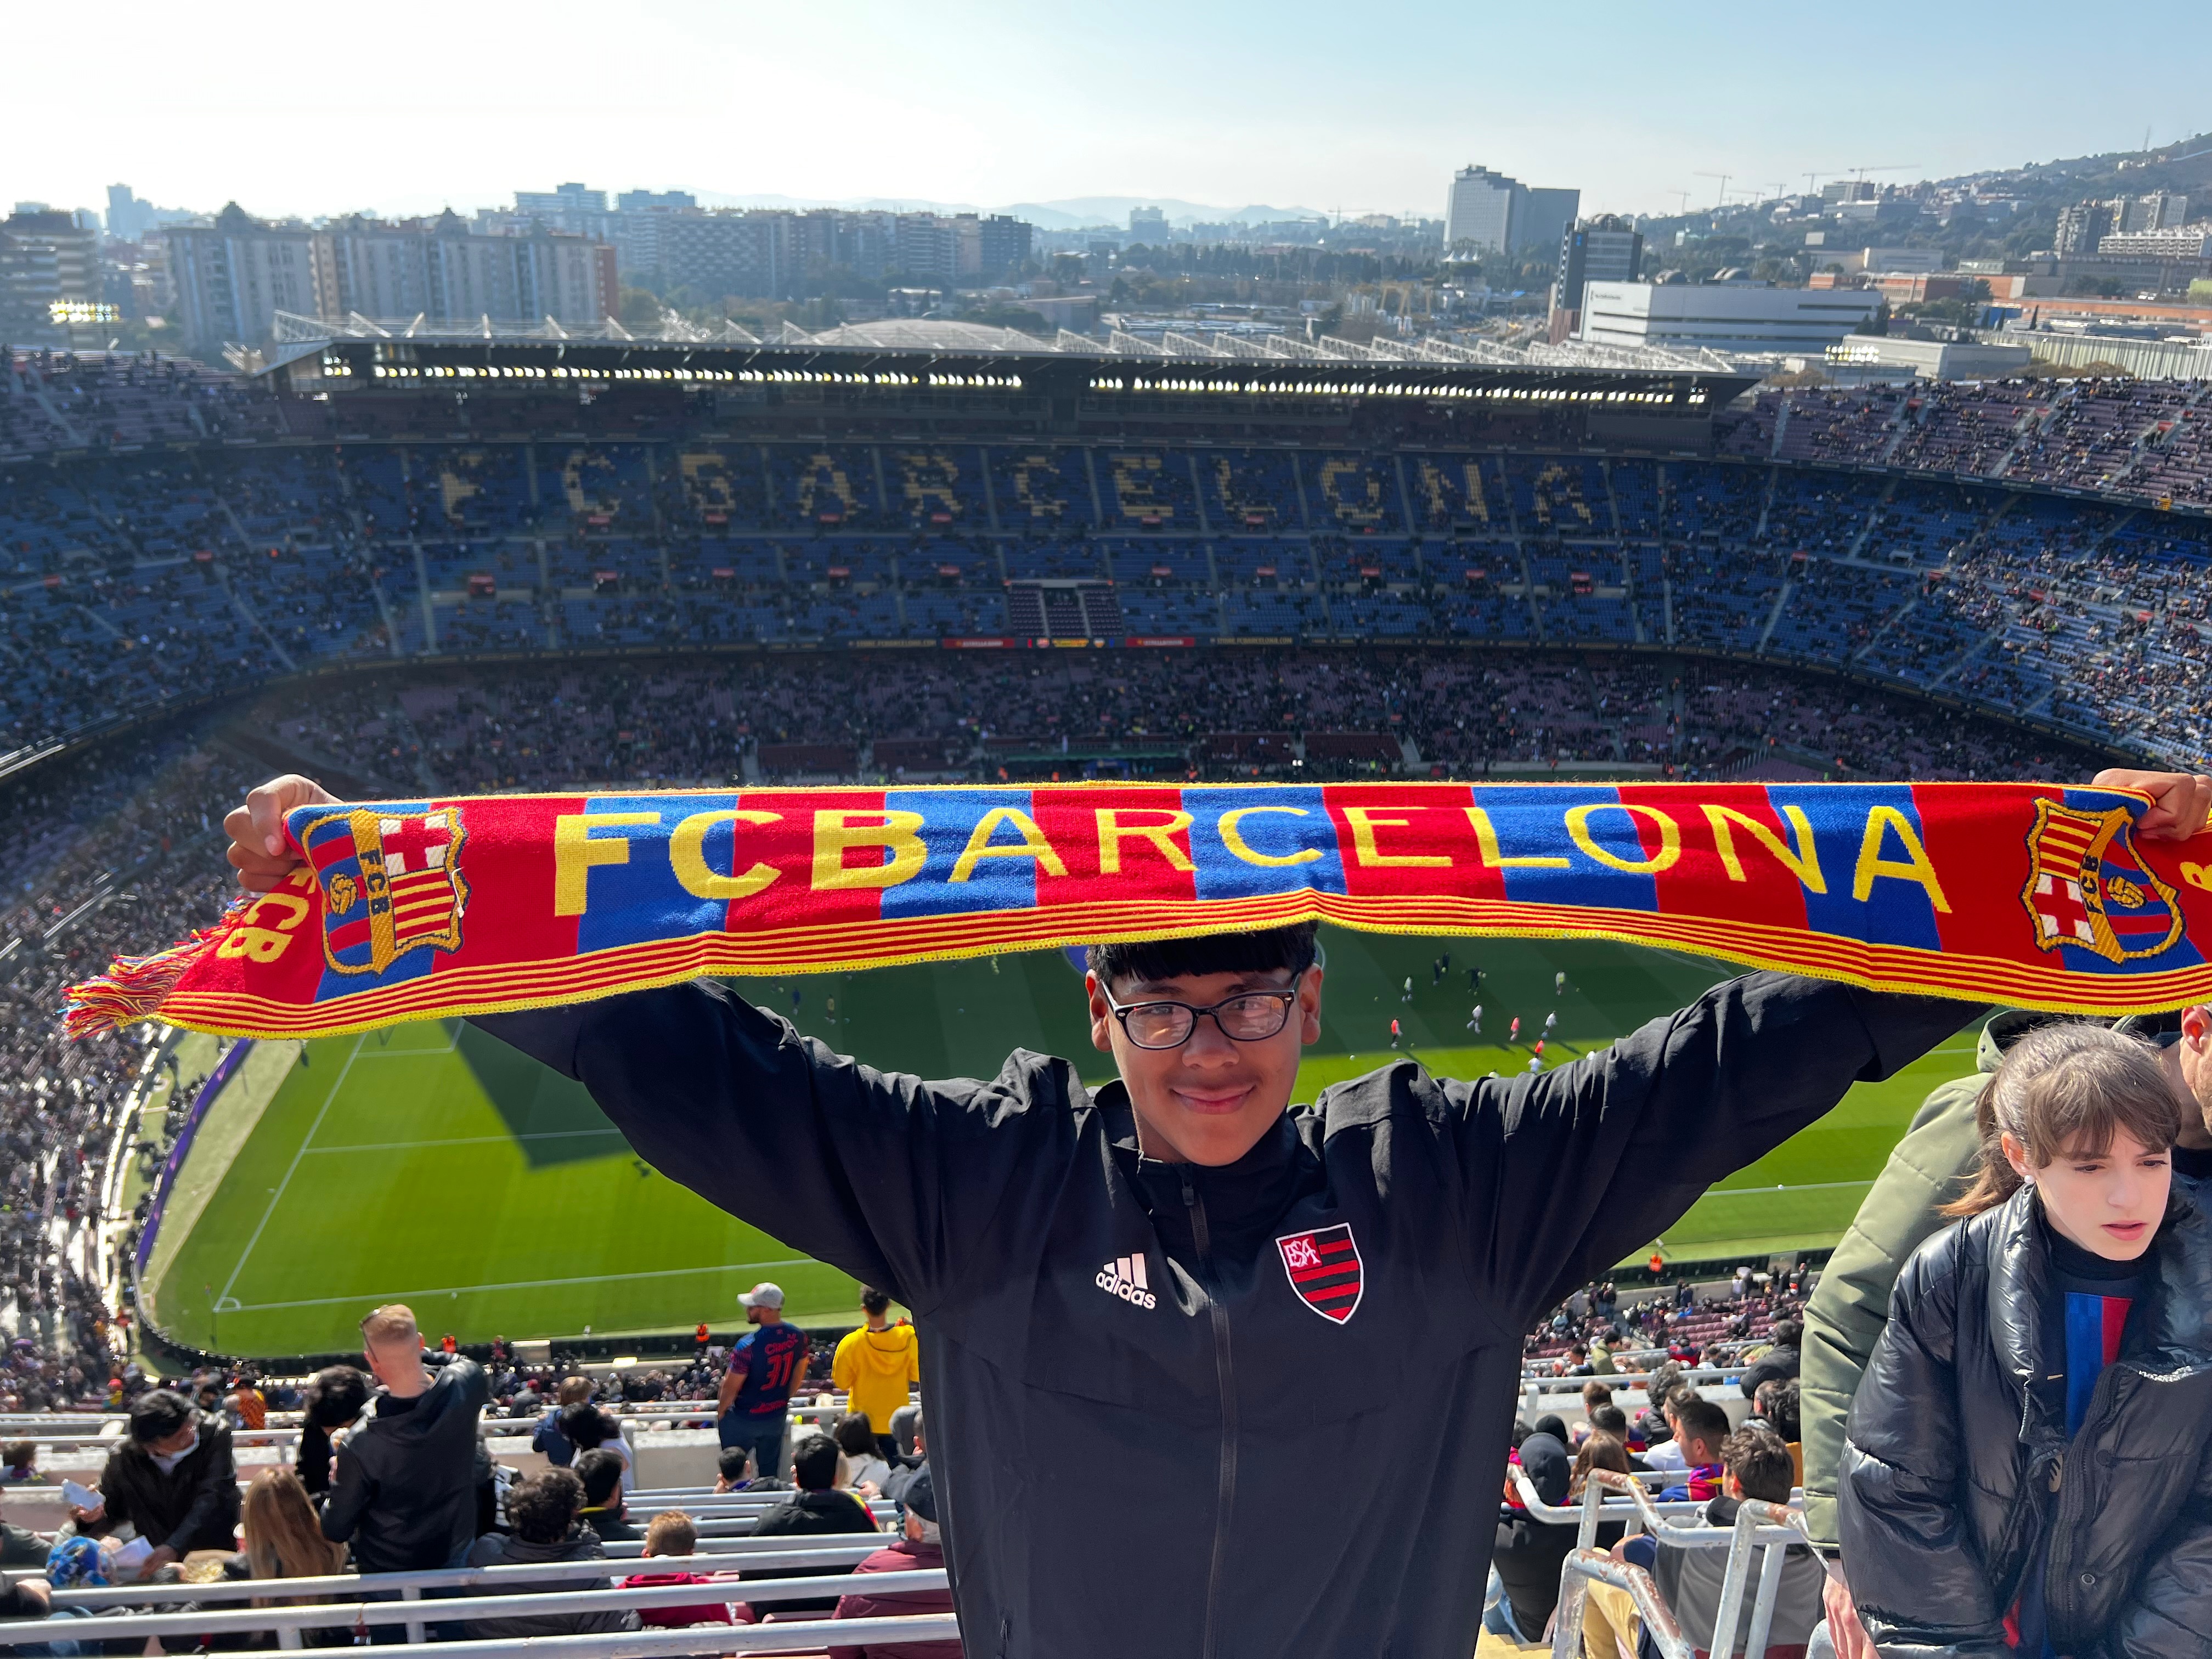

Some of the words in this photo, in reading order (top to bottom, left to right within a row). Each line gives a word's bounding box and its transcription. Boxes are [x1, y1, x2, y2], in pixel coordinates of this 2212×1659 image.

[360, 849, 390, 916] FCB
[1096, 1272, 1156, 1310] adidas
[759, 1350, 794, 1391] 31
